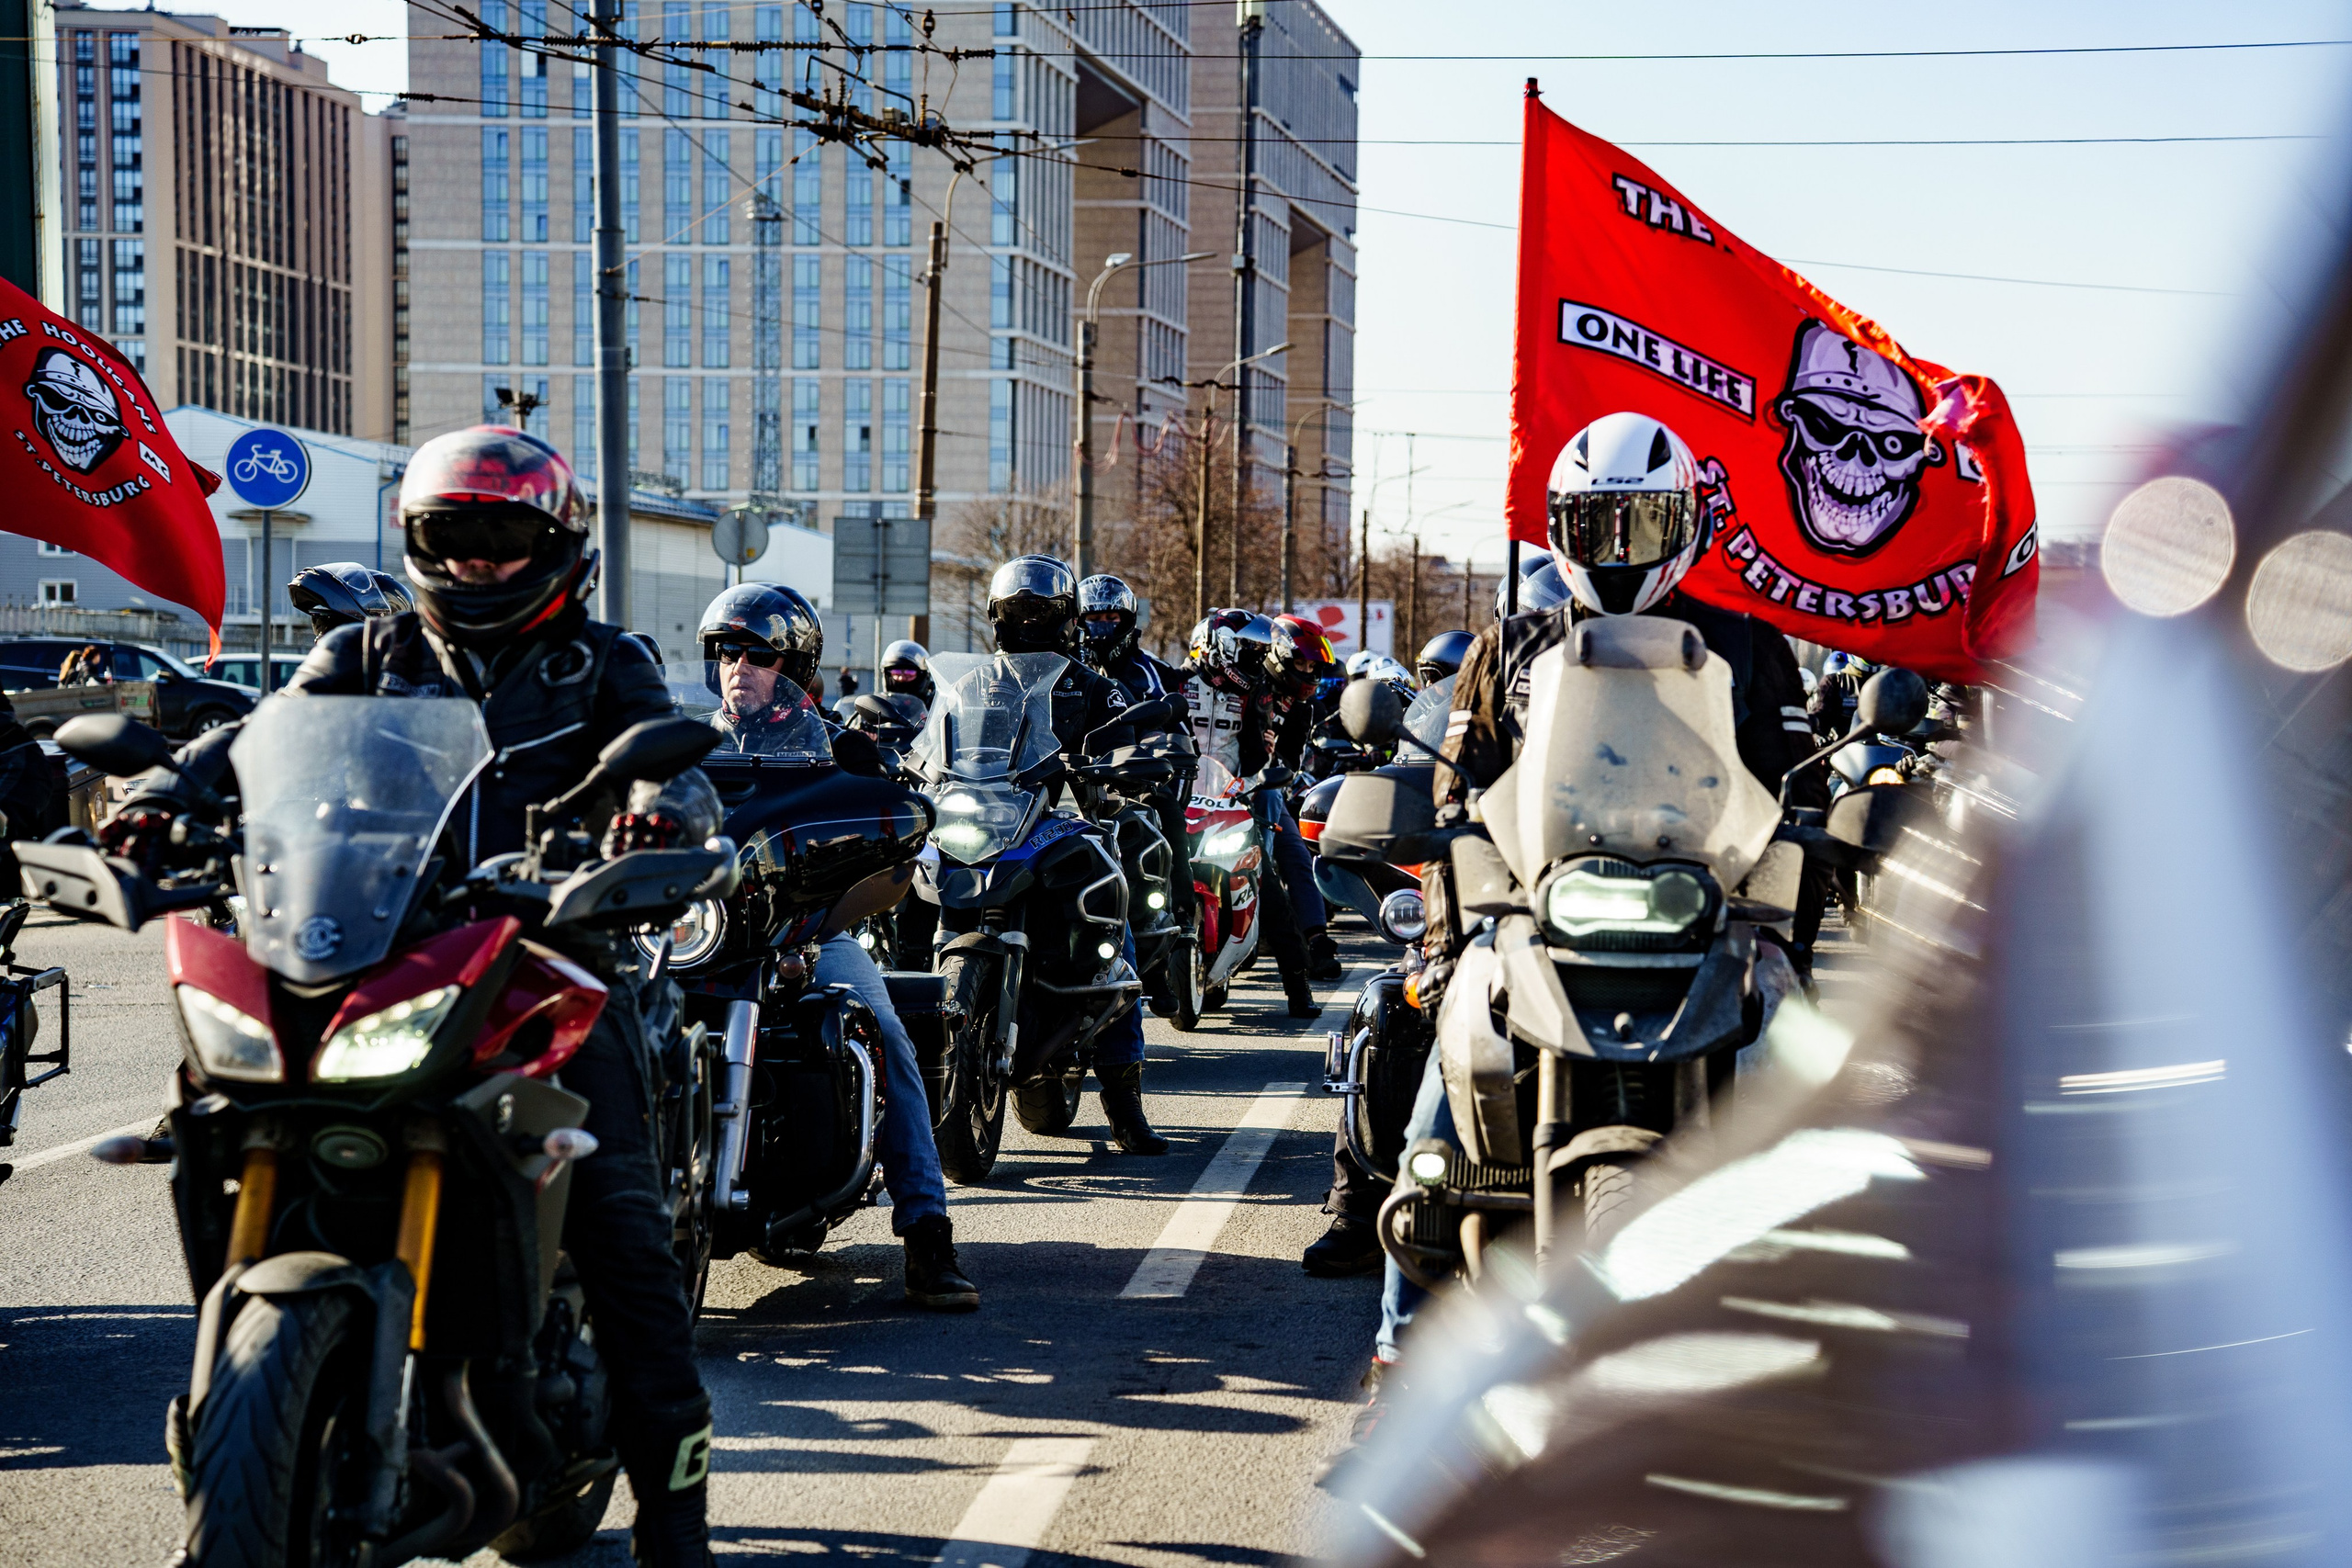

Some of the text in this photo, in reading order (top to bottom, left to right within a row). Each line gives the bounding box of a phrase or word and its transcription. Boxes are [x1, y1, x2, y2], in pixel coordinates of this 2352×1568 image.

[1615, 176, 1713, 243] THE
[0, 319, 159, 434] HE HOOLIGANS
[1576, 312, 1743, 406] ONE LIFE
[143, 452, 170, 479] MC
[1726, 525, 1976, 621] PETERSBUR
[1028, 820, 1074, 849] R1200
